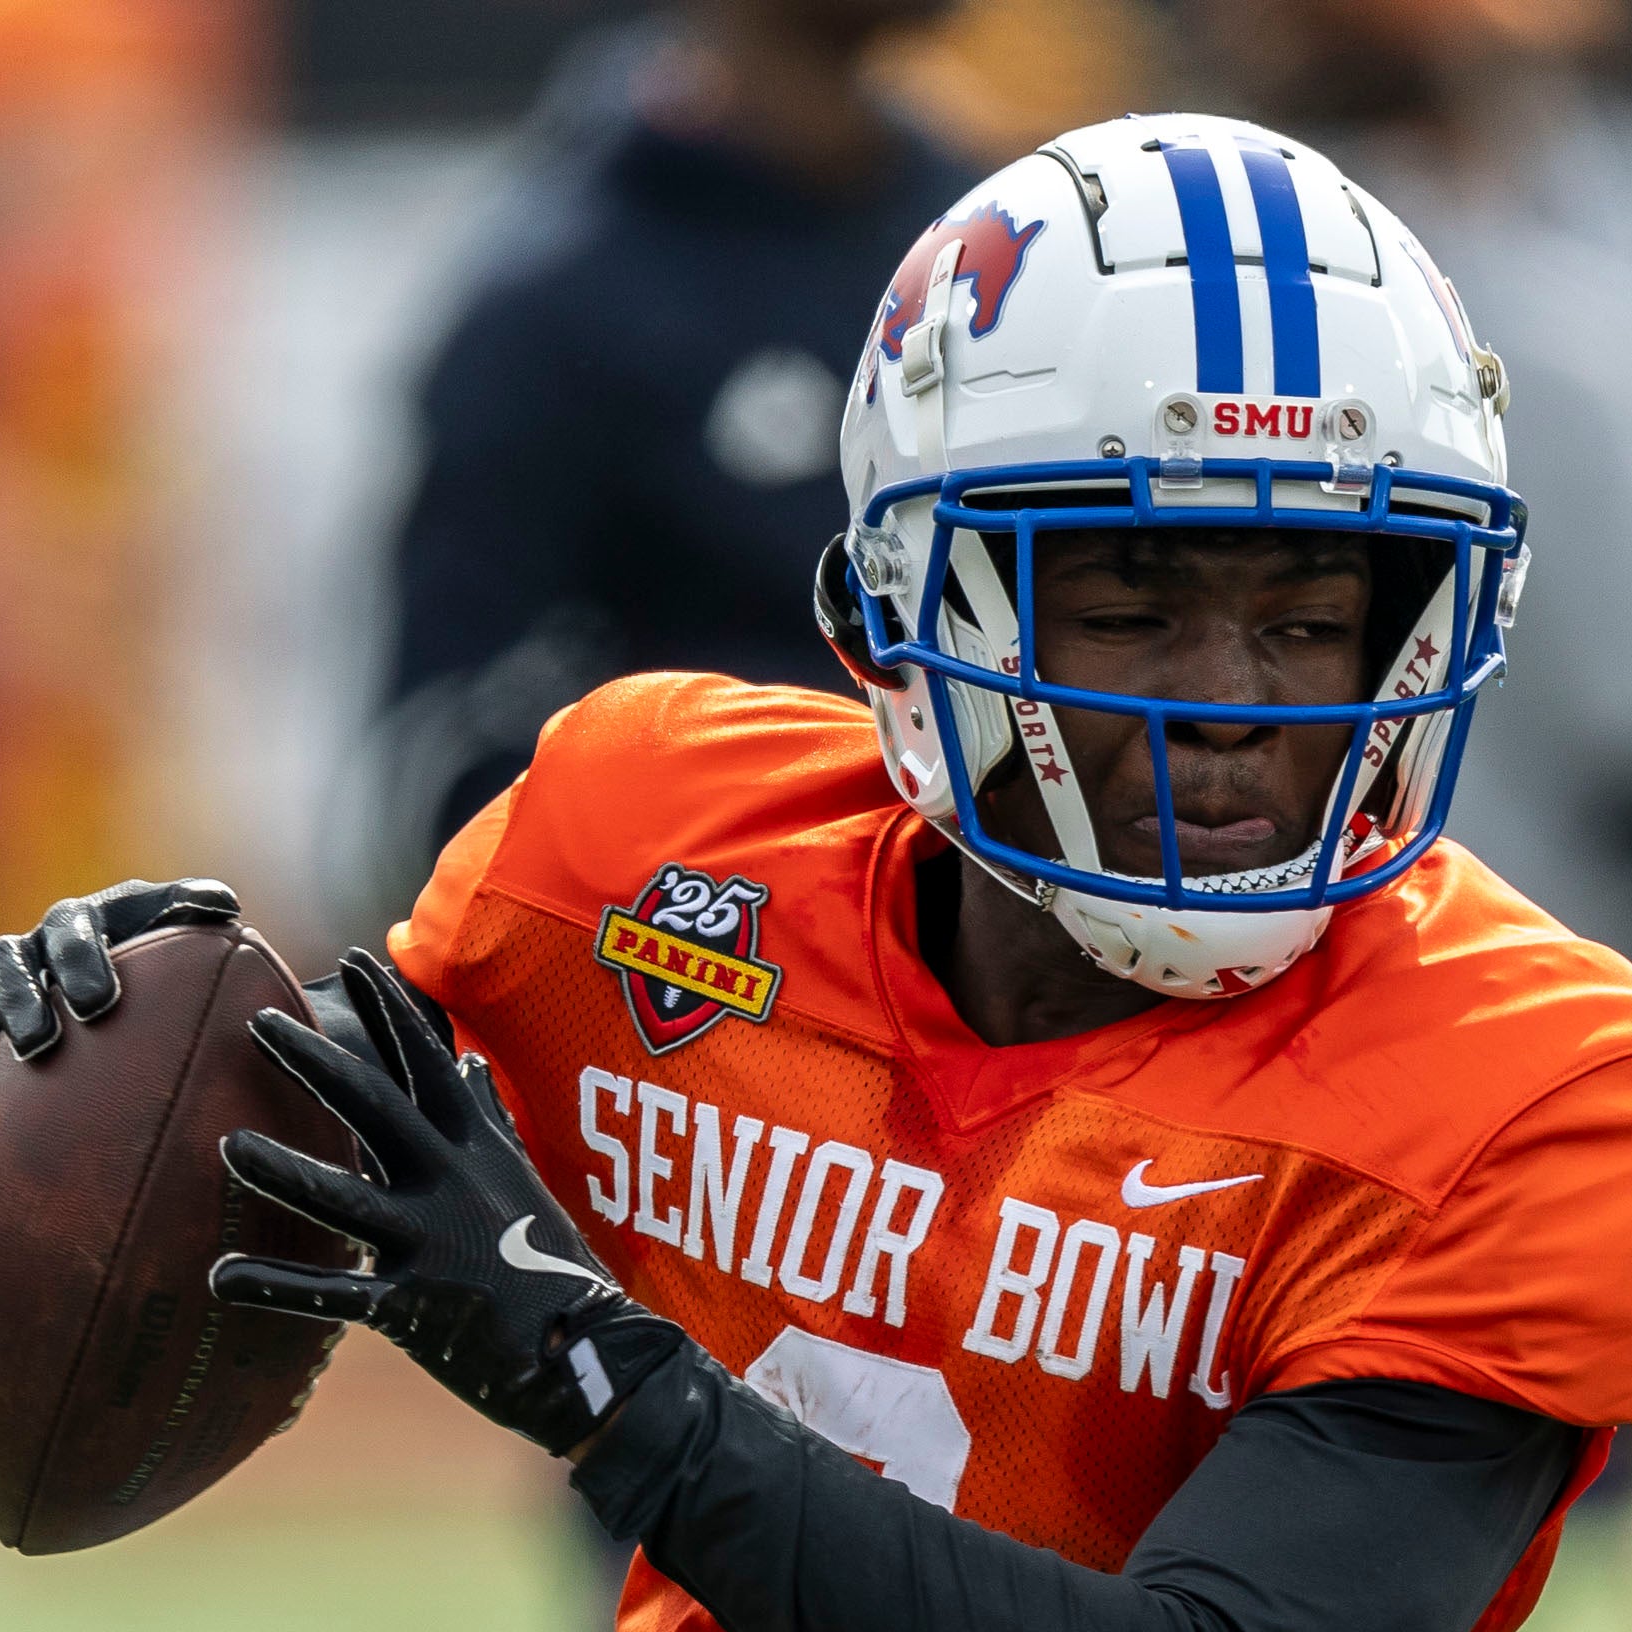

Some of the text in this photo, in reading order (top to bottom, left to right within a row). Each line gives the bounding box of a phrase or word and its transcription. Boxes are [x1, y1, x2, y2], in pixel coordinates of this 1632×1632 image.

[1213, 402, 1314, 439] SMU
[1000, 654, 1056, 758] SORT
[1363, 659, 1425, 769] SPRT
[612, 926, 762, 1002] PANINI
[578, 1065, 1247, 1411] SENIOR BOWL
